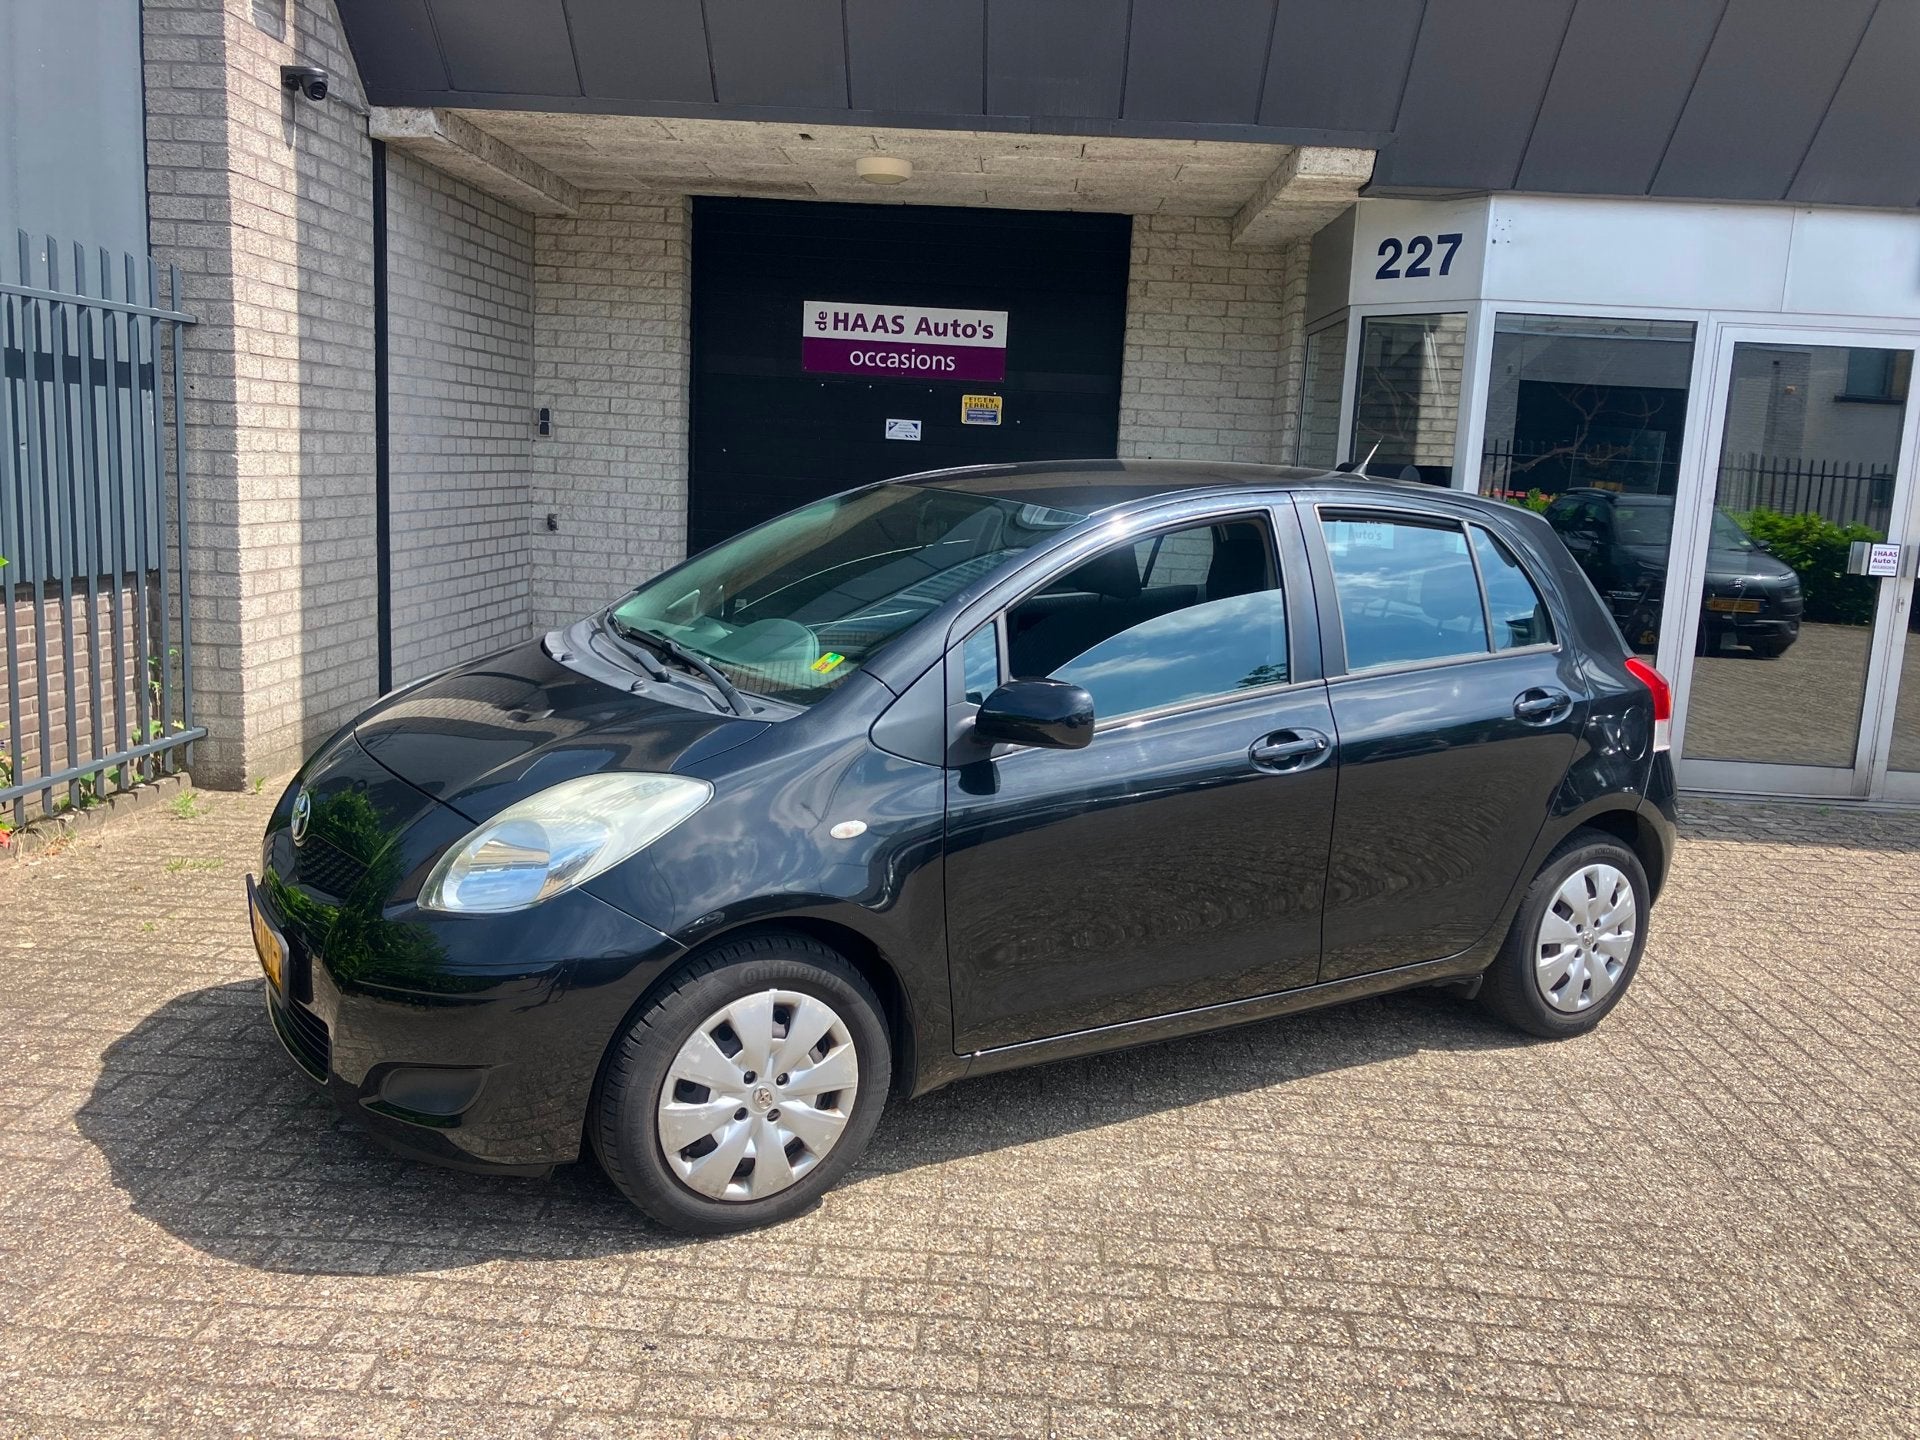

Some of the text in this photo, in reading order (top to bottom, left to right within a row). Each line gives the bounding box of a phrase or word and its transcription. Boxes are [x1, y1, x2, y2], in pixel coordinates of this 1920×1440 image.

[1375, 233, 1463, 280] 227
[815, 311, 994, 339] de HAAS Auto's
[849, 348, 956, 371] occasions
[1349, 529, 1383, 541] uto's
